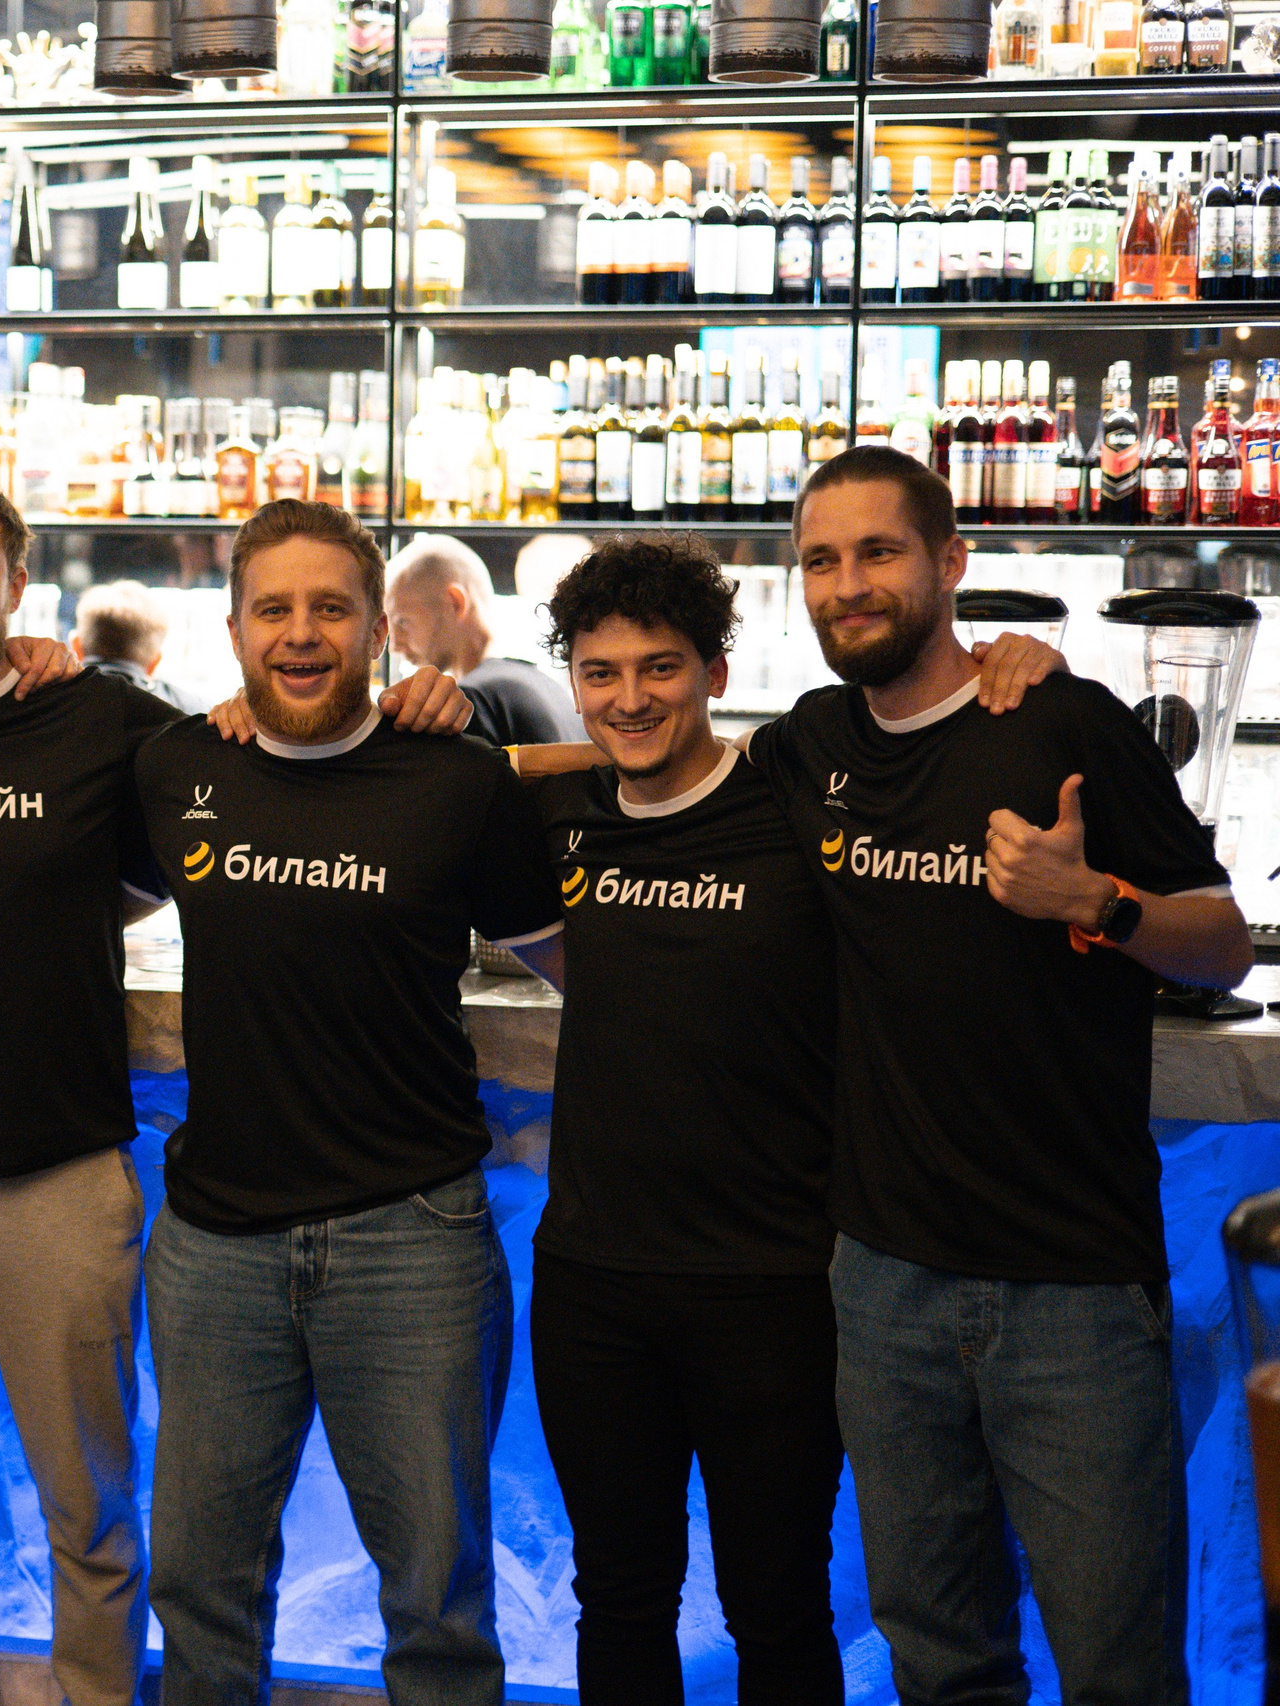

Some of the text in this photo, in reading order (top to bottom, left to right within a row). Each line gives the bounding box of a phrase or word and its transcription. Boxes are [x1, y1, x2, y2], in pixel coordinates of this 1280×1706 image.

[181, 808, 218, 819] JÖGEL
[224, 844, 387, 894] билайн
[595, 867, 746, 911] билайн
